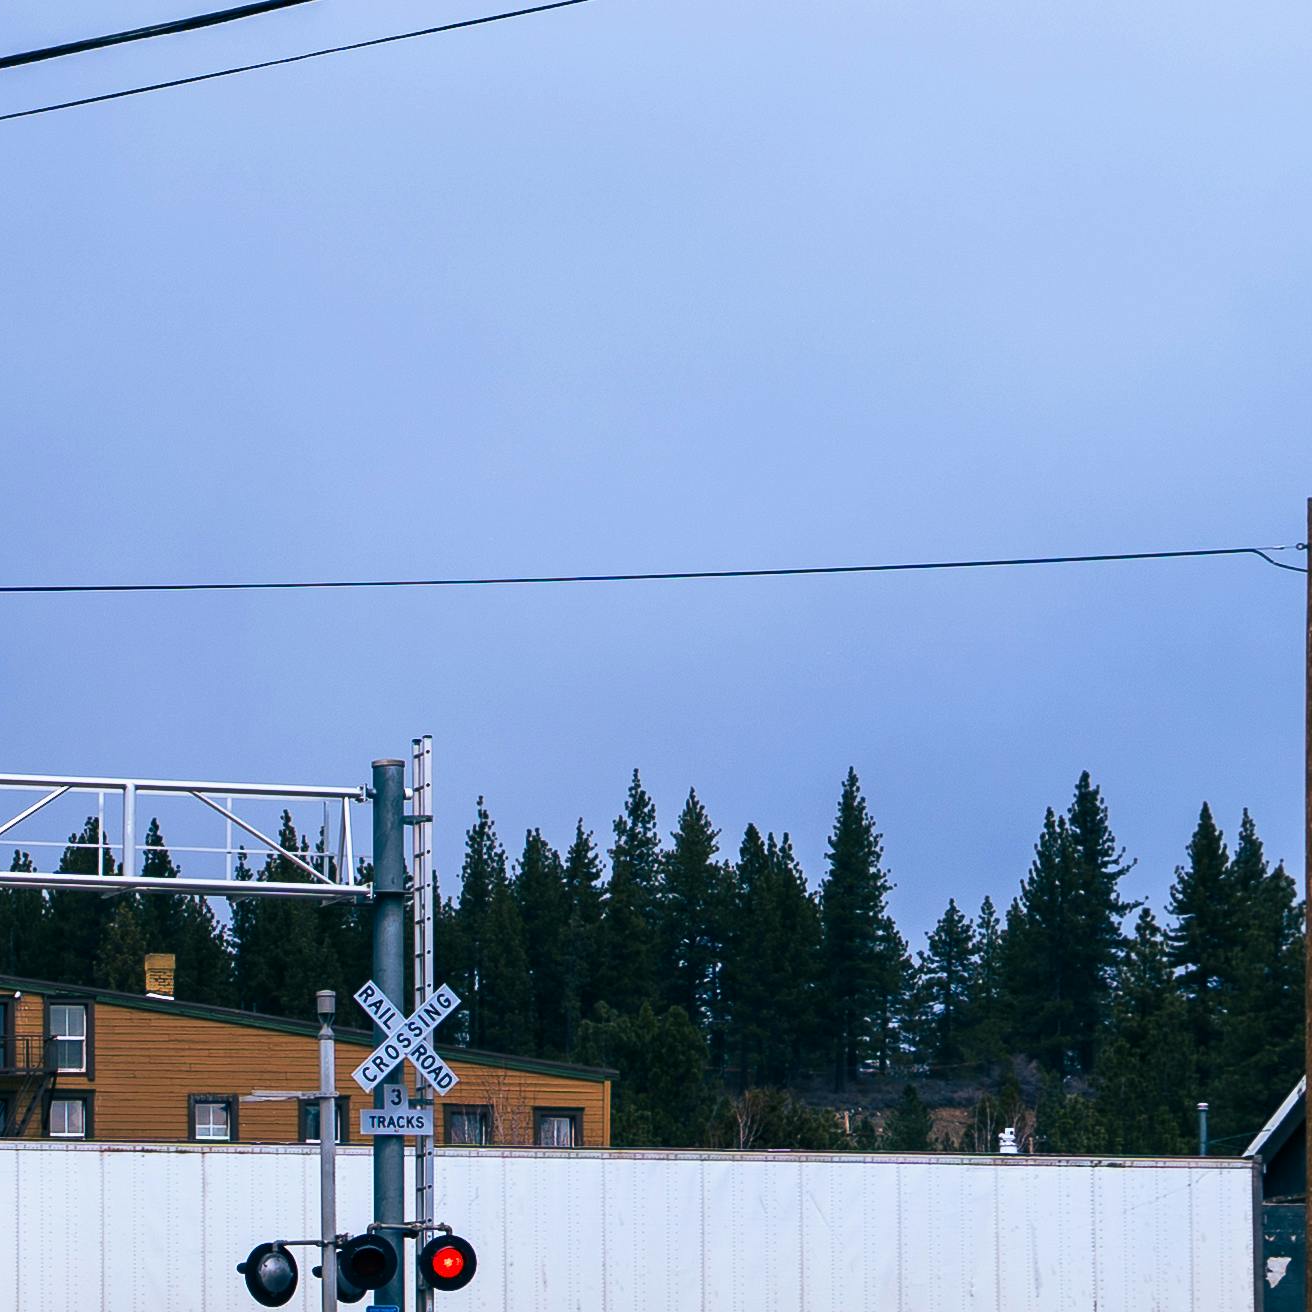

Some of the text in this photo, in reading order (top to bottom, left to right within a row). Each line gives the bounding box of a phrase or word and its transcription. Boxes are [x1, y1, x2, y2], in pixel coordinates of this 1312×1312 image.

[358, 985, 453, 1090] RAIL ROAD
[362, 993, 452, 1083] CROSSING
[369, 1115, 425, 1129] TRACKS
[390, 1088, 402, 1106] 3
